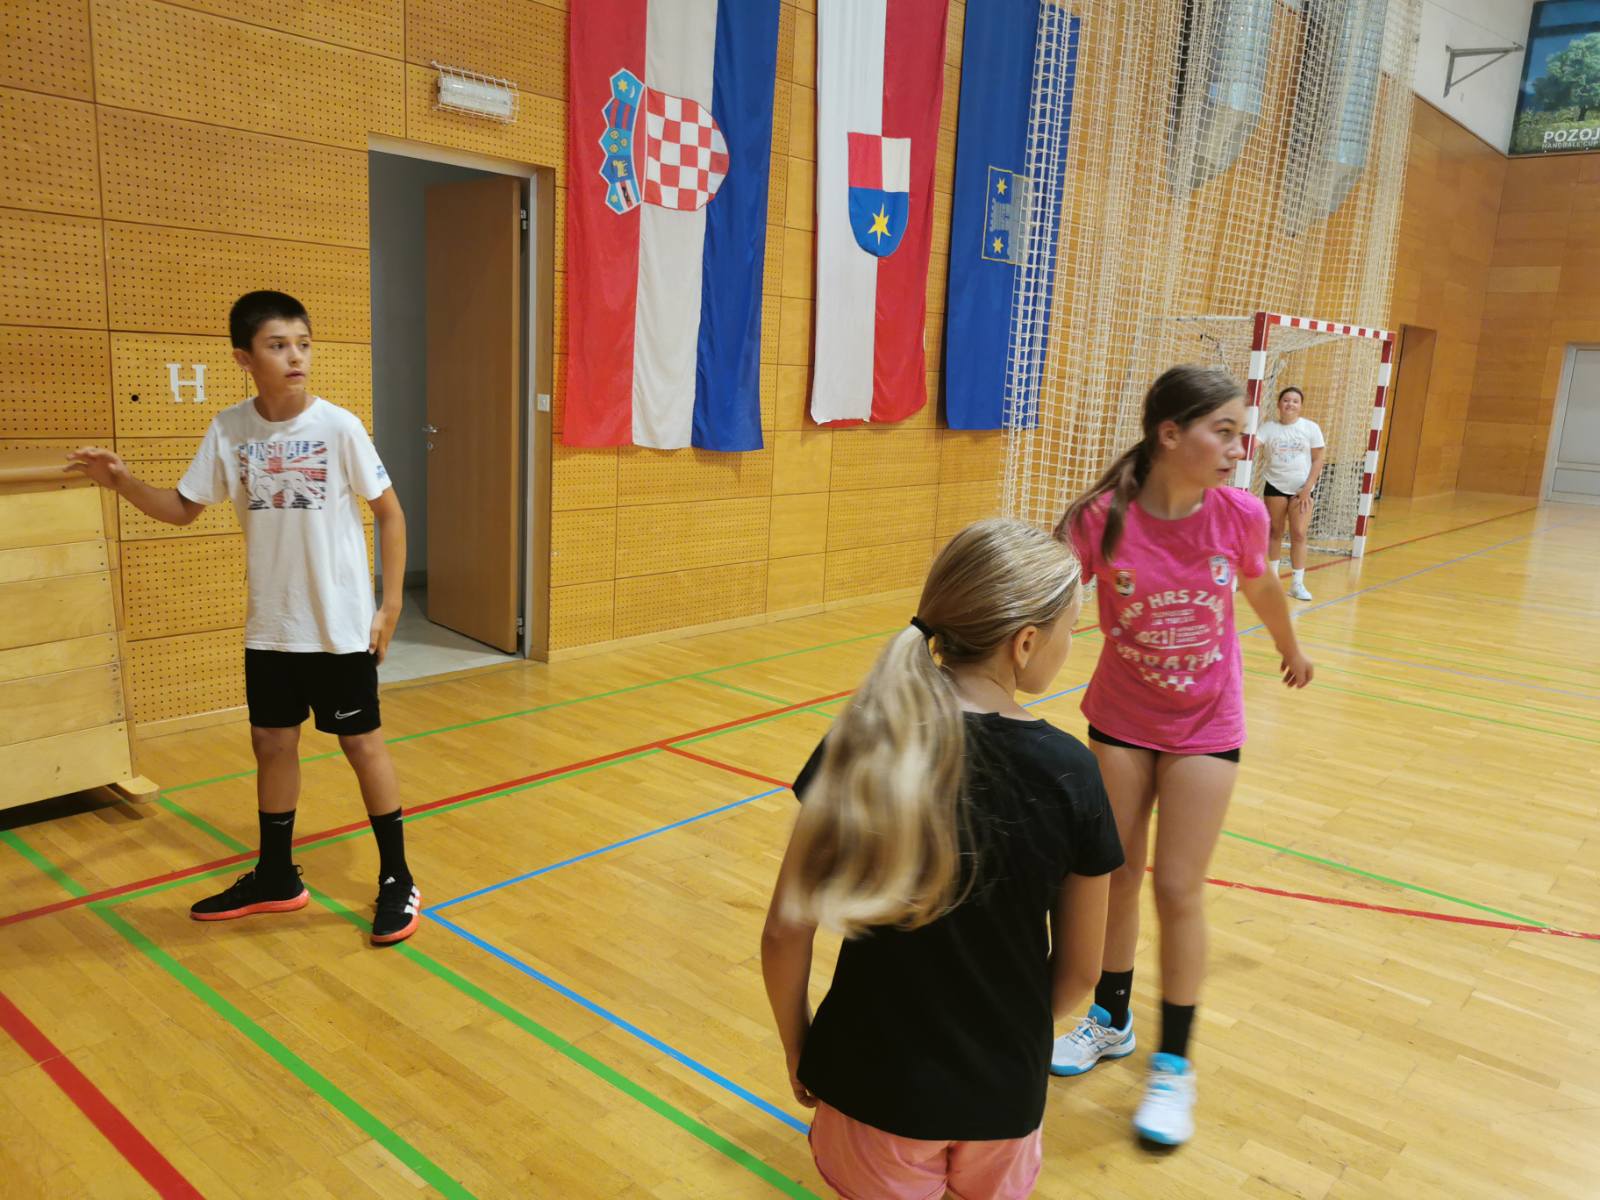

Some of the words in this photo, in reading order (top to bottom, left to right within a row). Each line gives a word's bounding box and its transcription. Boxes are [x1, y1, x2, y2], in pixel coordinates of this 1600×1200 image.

[1544, 127, 1600, 143] POZOJ
[166, 363, 208, 402] H
[1147, 589, 1190, 609] HRS
